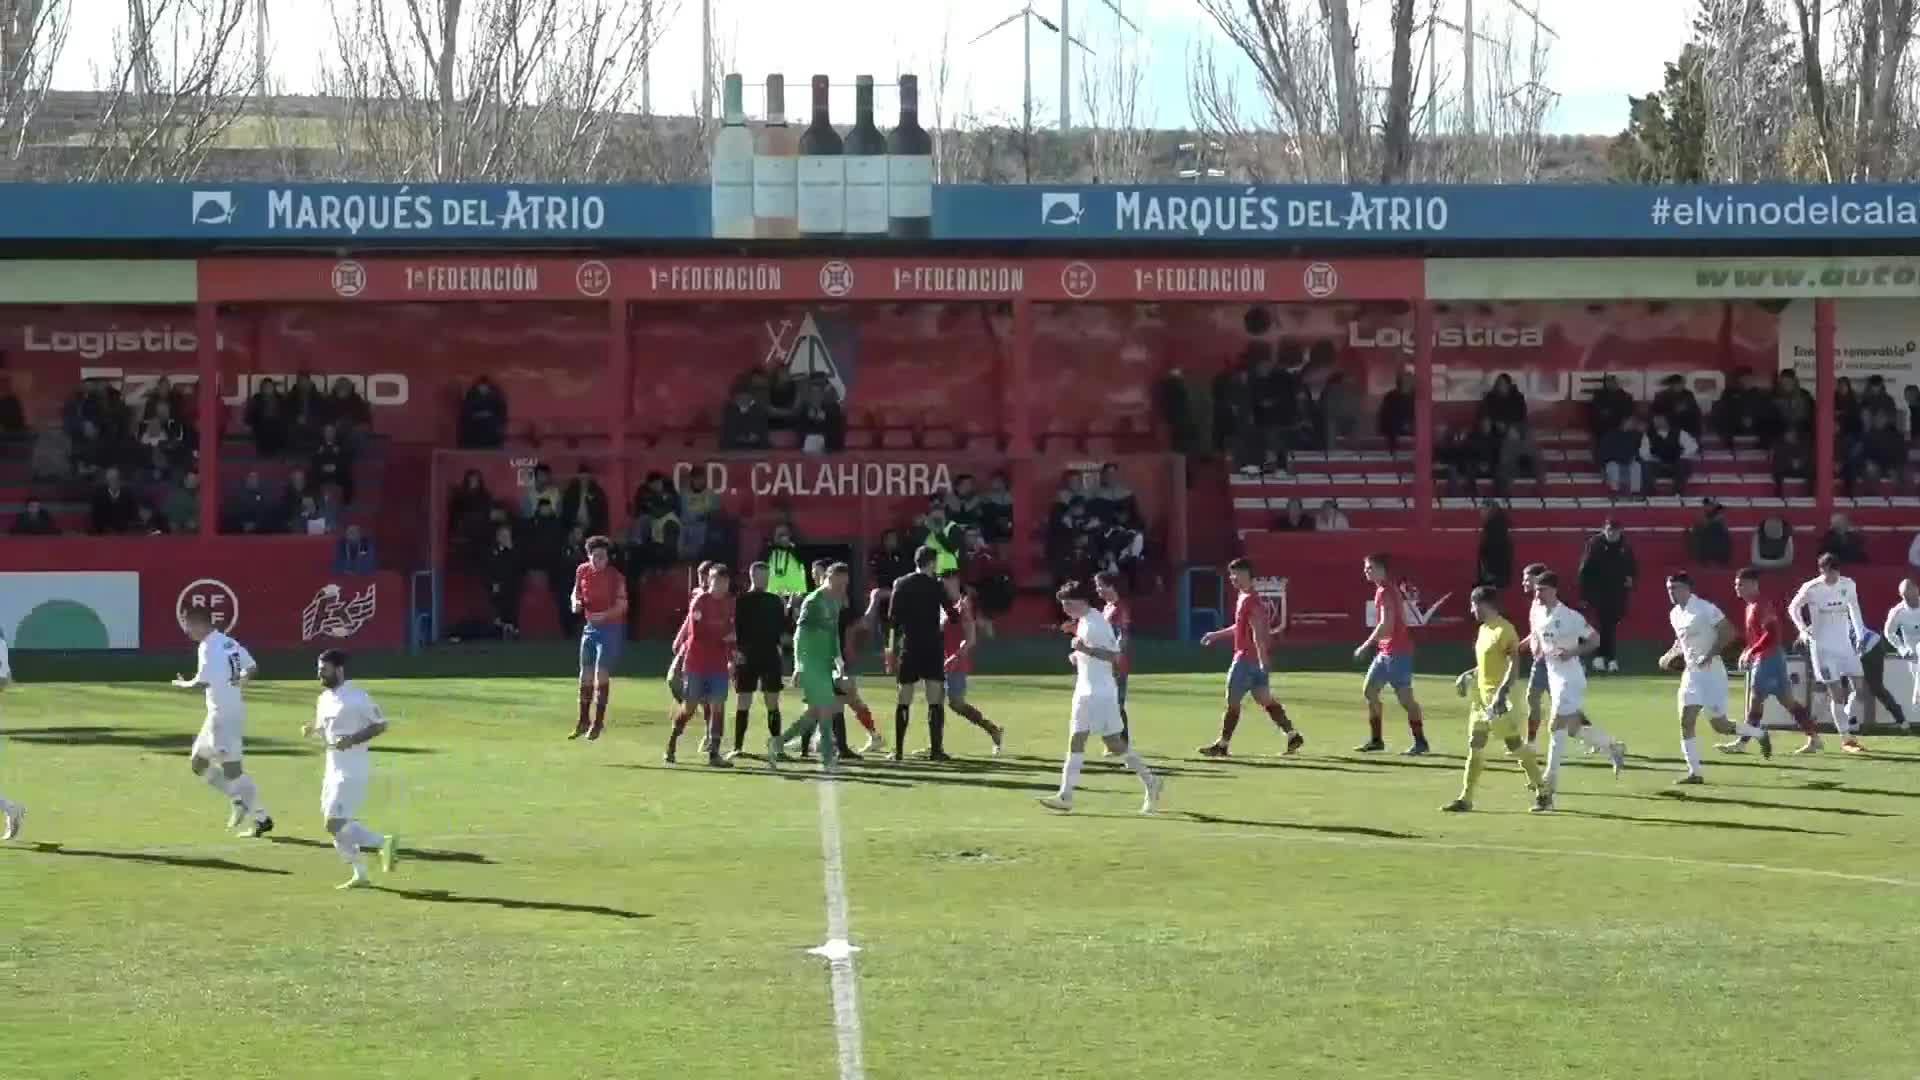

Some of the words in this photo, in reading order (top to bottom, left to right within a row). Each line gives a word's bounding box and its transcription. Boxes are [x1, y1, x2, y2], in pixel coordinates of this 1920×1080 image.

[267, 186, 432, 235] MARQUÉS
[443, 199, 495, 226] DEL
[498, 190, 606, 231] ATRIO
[1115, 187, 1279, 236] MARQUÉS
[1288, 200, 1340, 227] DEL
[1342, 191, 1448, 231] ATRIO
[1650, 195, 1920, 226] #elvinodelcala
[1696, 263, 1920, 287] www.auto
[23, 324, 224, 358] Logístic
[672, 461, 738, 496] CD.
[750, 461, 951, 497] CALAHORRA
